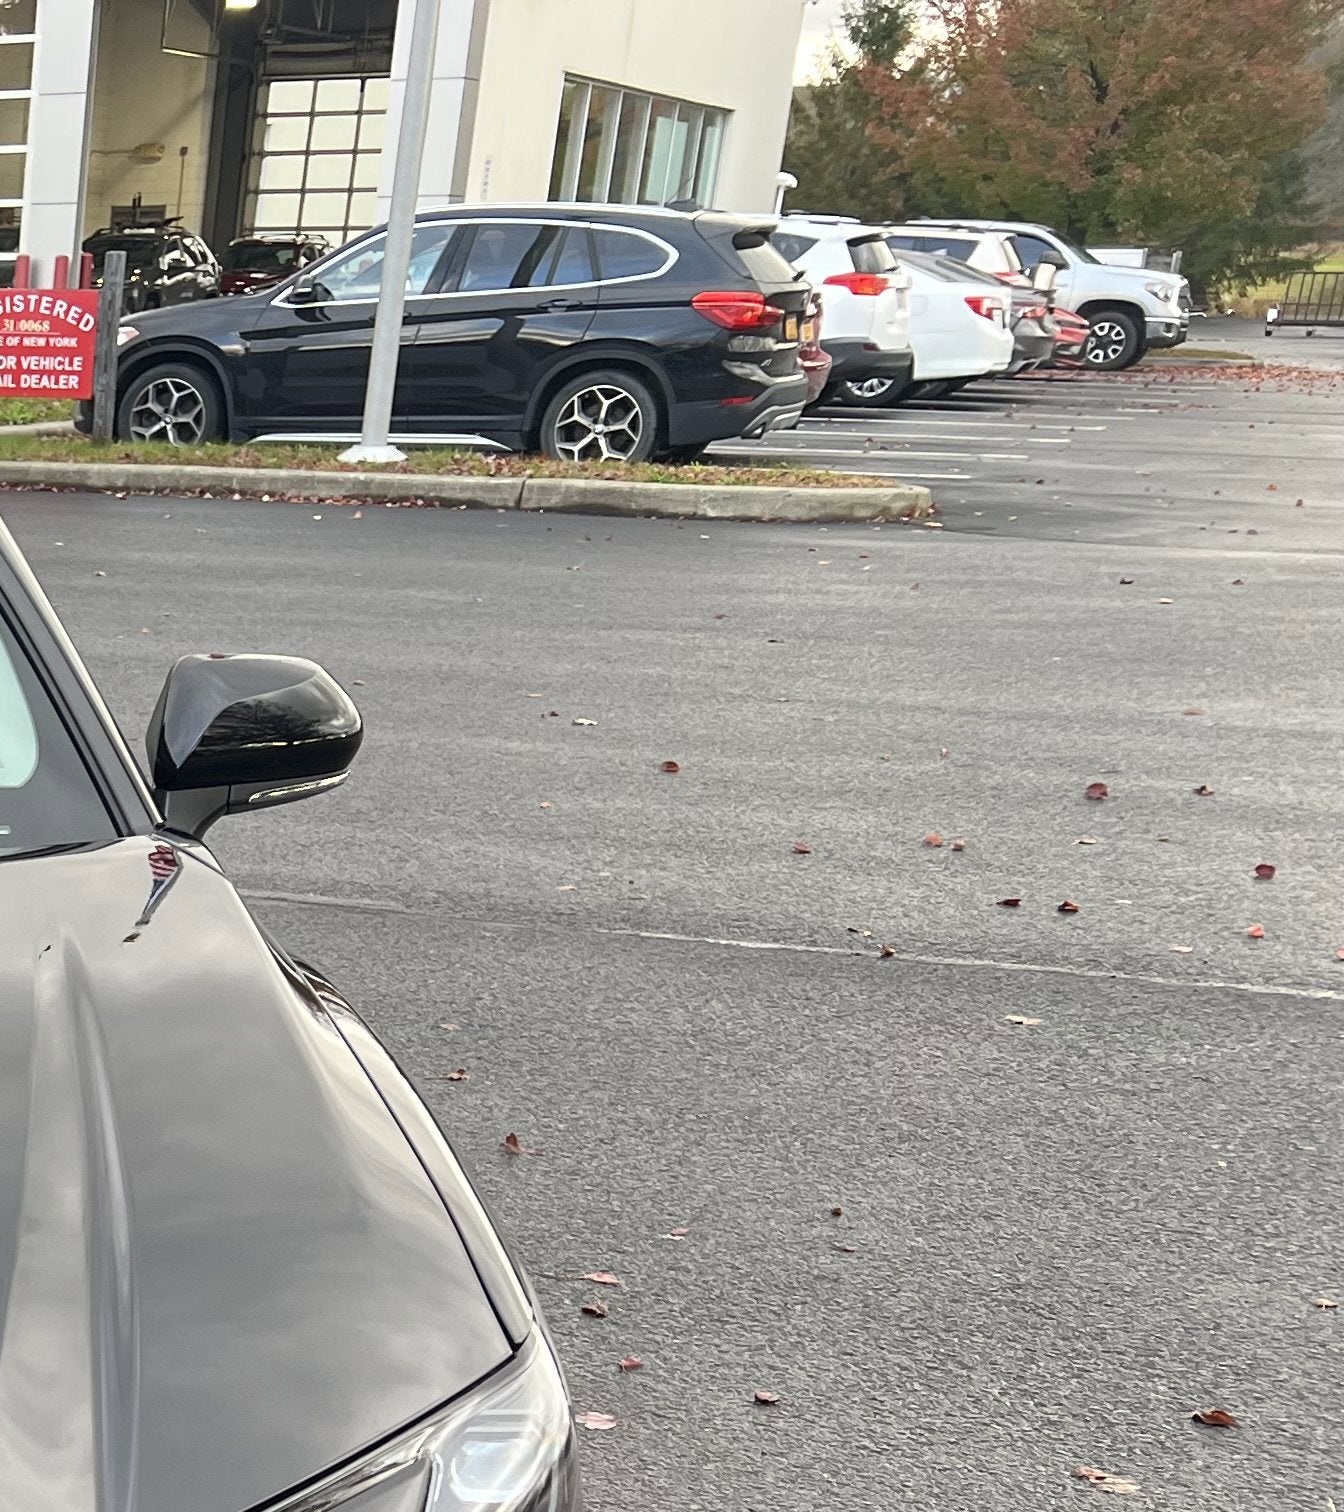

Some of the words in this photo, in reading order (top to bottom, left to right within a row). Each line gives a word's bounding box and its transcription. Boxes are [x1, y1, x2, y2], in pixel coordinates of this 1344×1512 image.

[5, 336, 21, 347] OF
[22, 336, 47, 348] NEW
[48, 337, 78, 348] YORK
[20, 355, 83, 371] VEHICLE
[20, 373, 79, 389] DEALER
